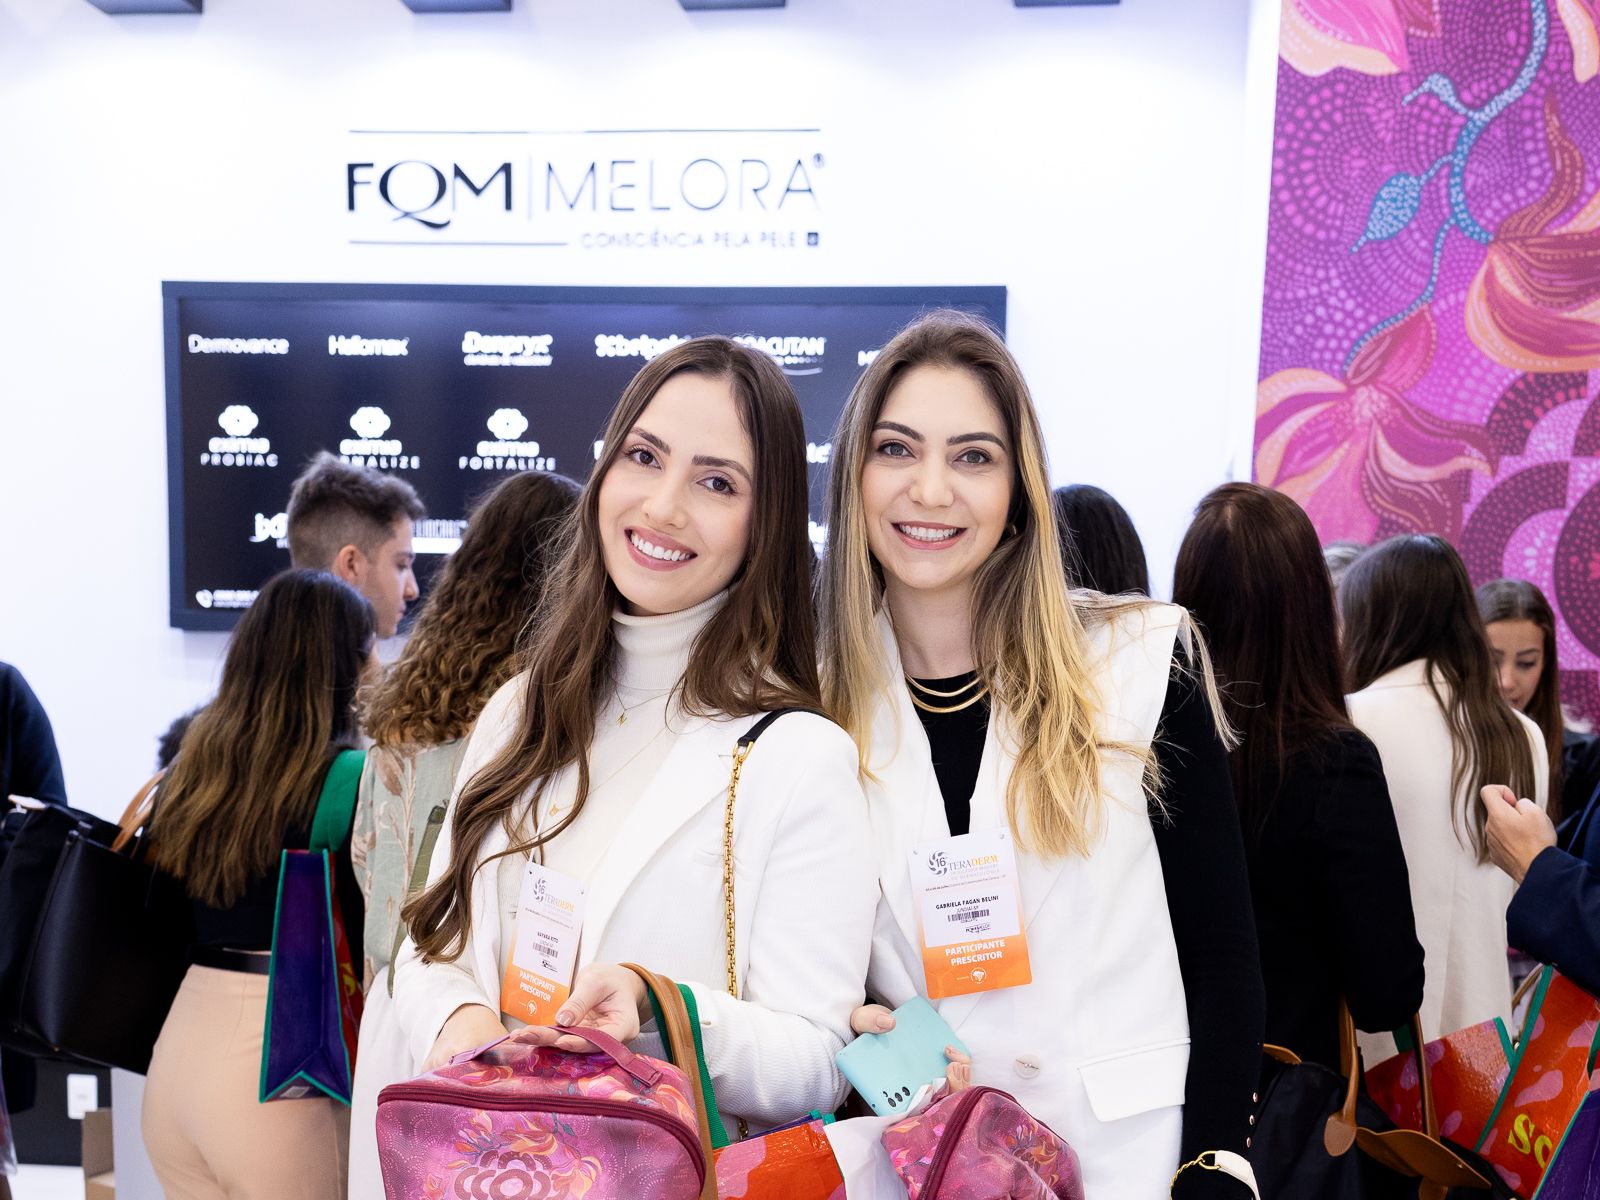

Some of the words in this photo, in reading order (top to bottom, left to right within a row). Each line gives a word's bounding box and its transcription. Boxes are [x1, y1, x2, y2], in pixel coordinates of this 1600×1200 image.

[346, 160, 513, 230] FQM
[713, 231, 751, 248] PELA
[760, 231, 796, 248] PELE
[458, 456, 557, 471] FORTALIZE
[945, 939, 1006, 957] PARTICIPANTE
[951, 950, 1003, 967] PRESCRITOR
